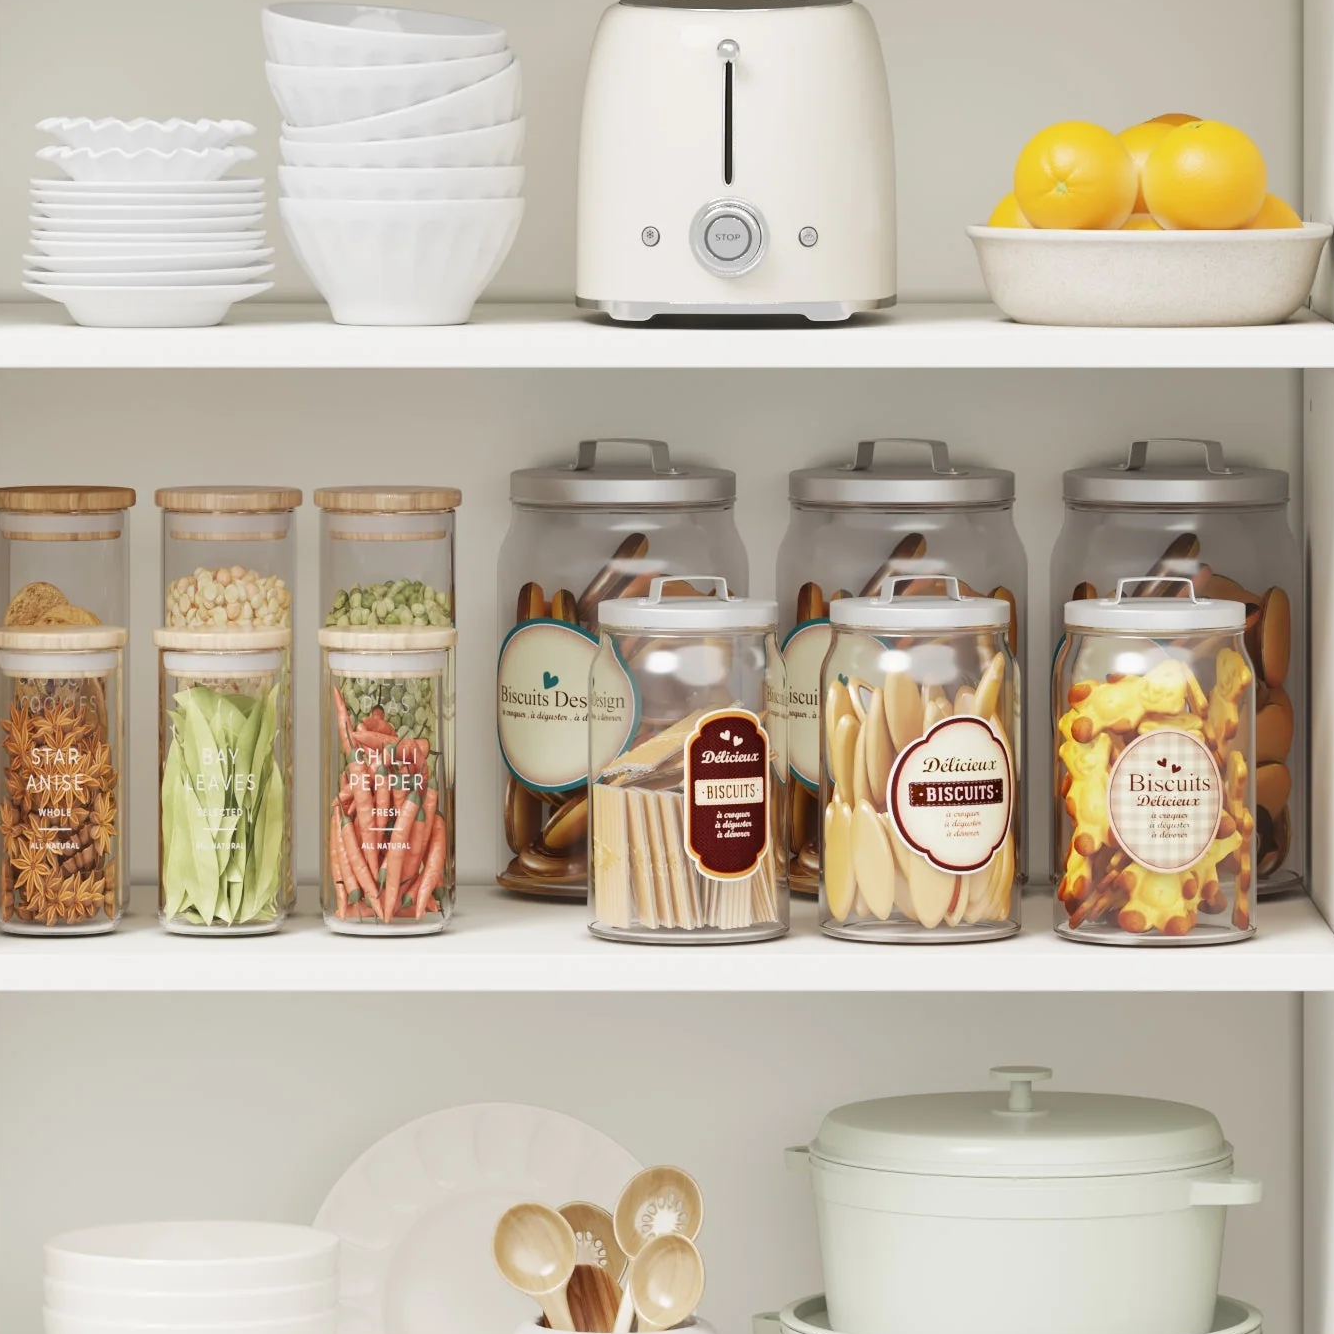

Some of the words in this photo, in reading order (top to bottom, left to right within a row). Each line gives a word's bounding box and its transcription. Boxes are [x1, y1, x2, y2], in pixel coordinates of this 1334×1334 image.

[501, 684, 549, 707] Biscuits
[31, 748, 79, 765] STAR
[202, 748, 238, 765] BAY
[355, 748, 417, 765] CHILLI
[701, 750, 759, 764] Délicieux
[922, 757, 997, 773] Délicieux
[26, 774, 84, 791] ANISE
[185, 774, 256, 791] LEAVES
[349, 774, 423, 791] PEPPER
[1129, 773, 1211, 792] Biscuits
[1137, 794, 1200, 807] Délicieux
[38, 809, 72, 817] WHOLE
[372, 809, 401, 817] FRESH
